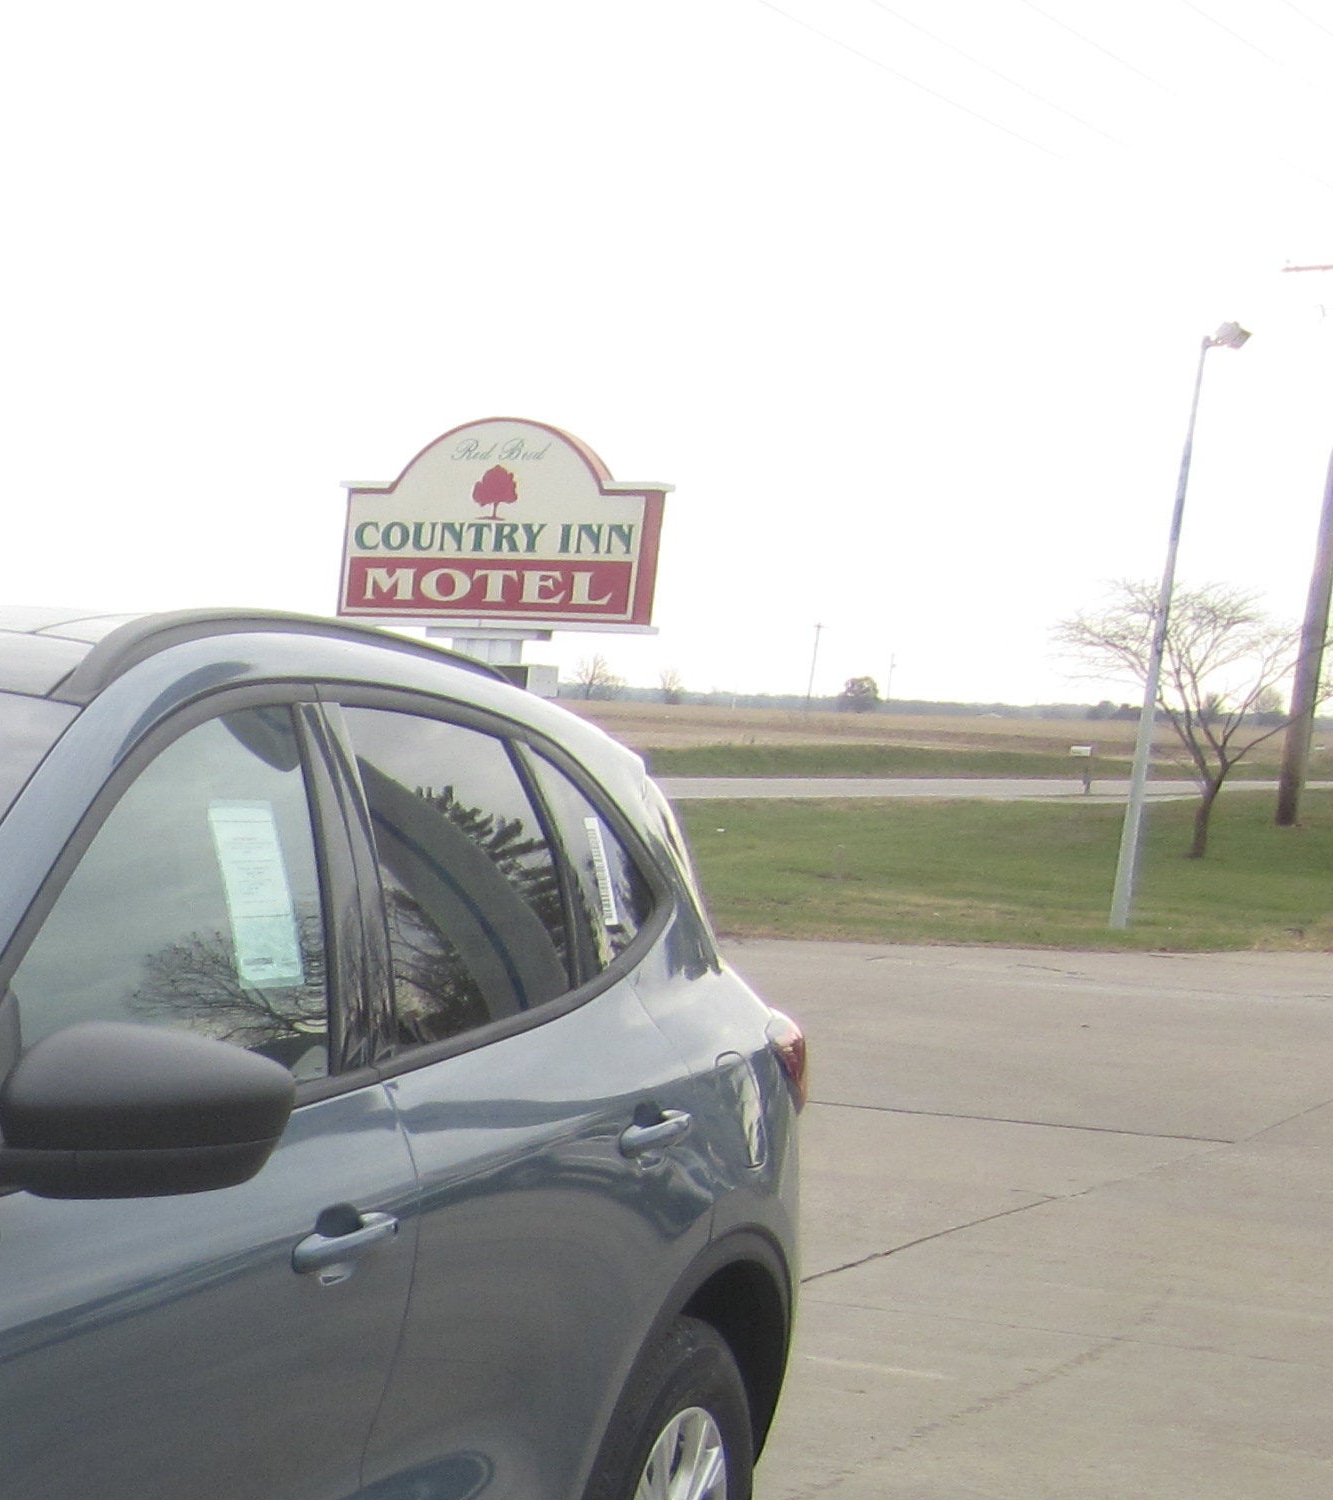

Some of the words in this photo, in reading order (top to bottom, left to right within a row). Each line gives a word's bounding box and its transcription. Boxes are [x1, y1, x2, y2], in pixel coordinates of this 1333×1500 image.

[452, 438, 493, 461] Red
[498, 437, 551, 461] Bud
[354, 521, 546, 553] COUNTRY
[558, 523, 634, 554] INN
[362, 567, 612, 606] MOTEL
